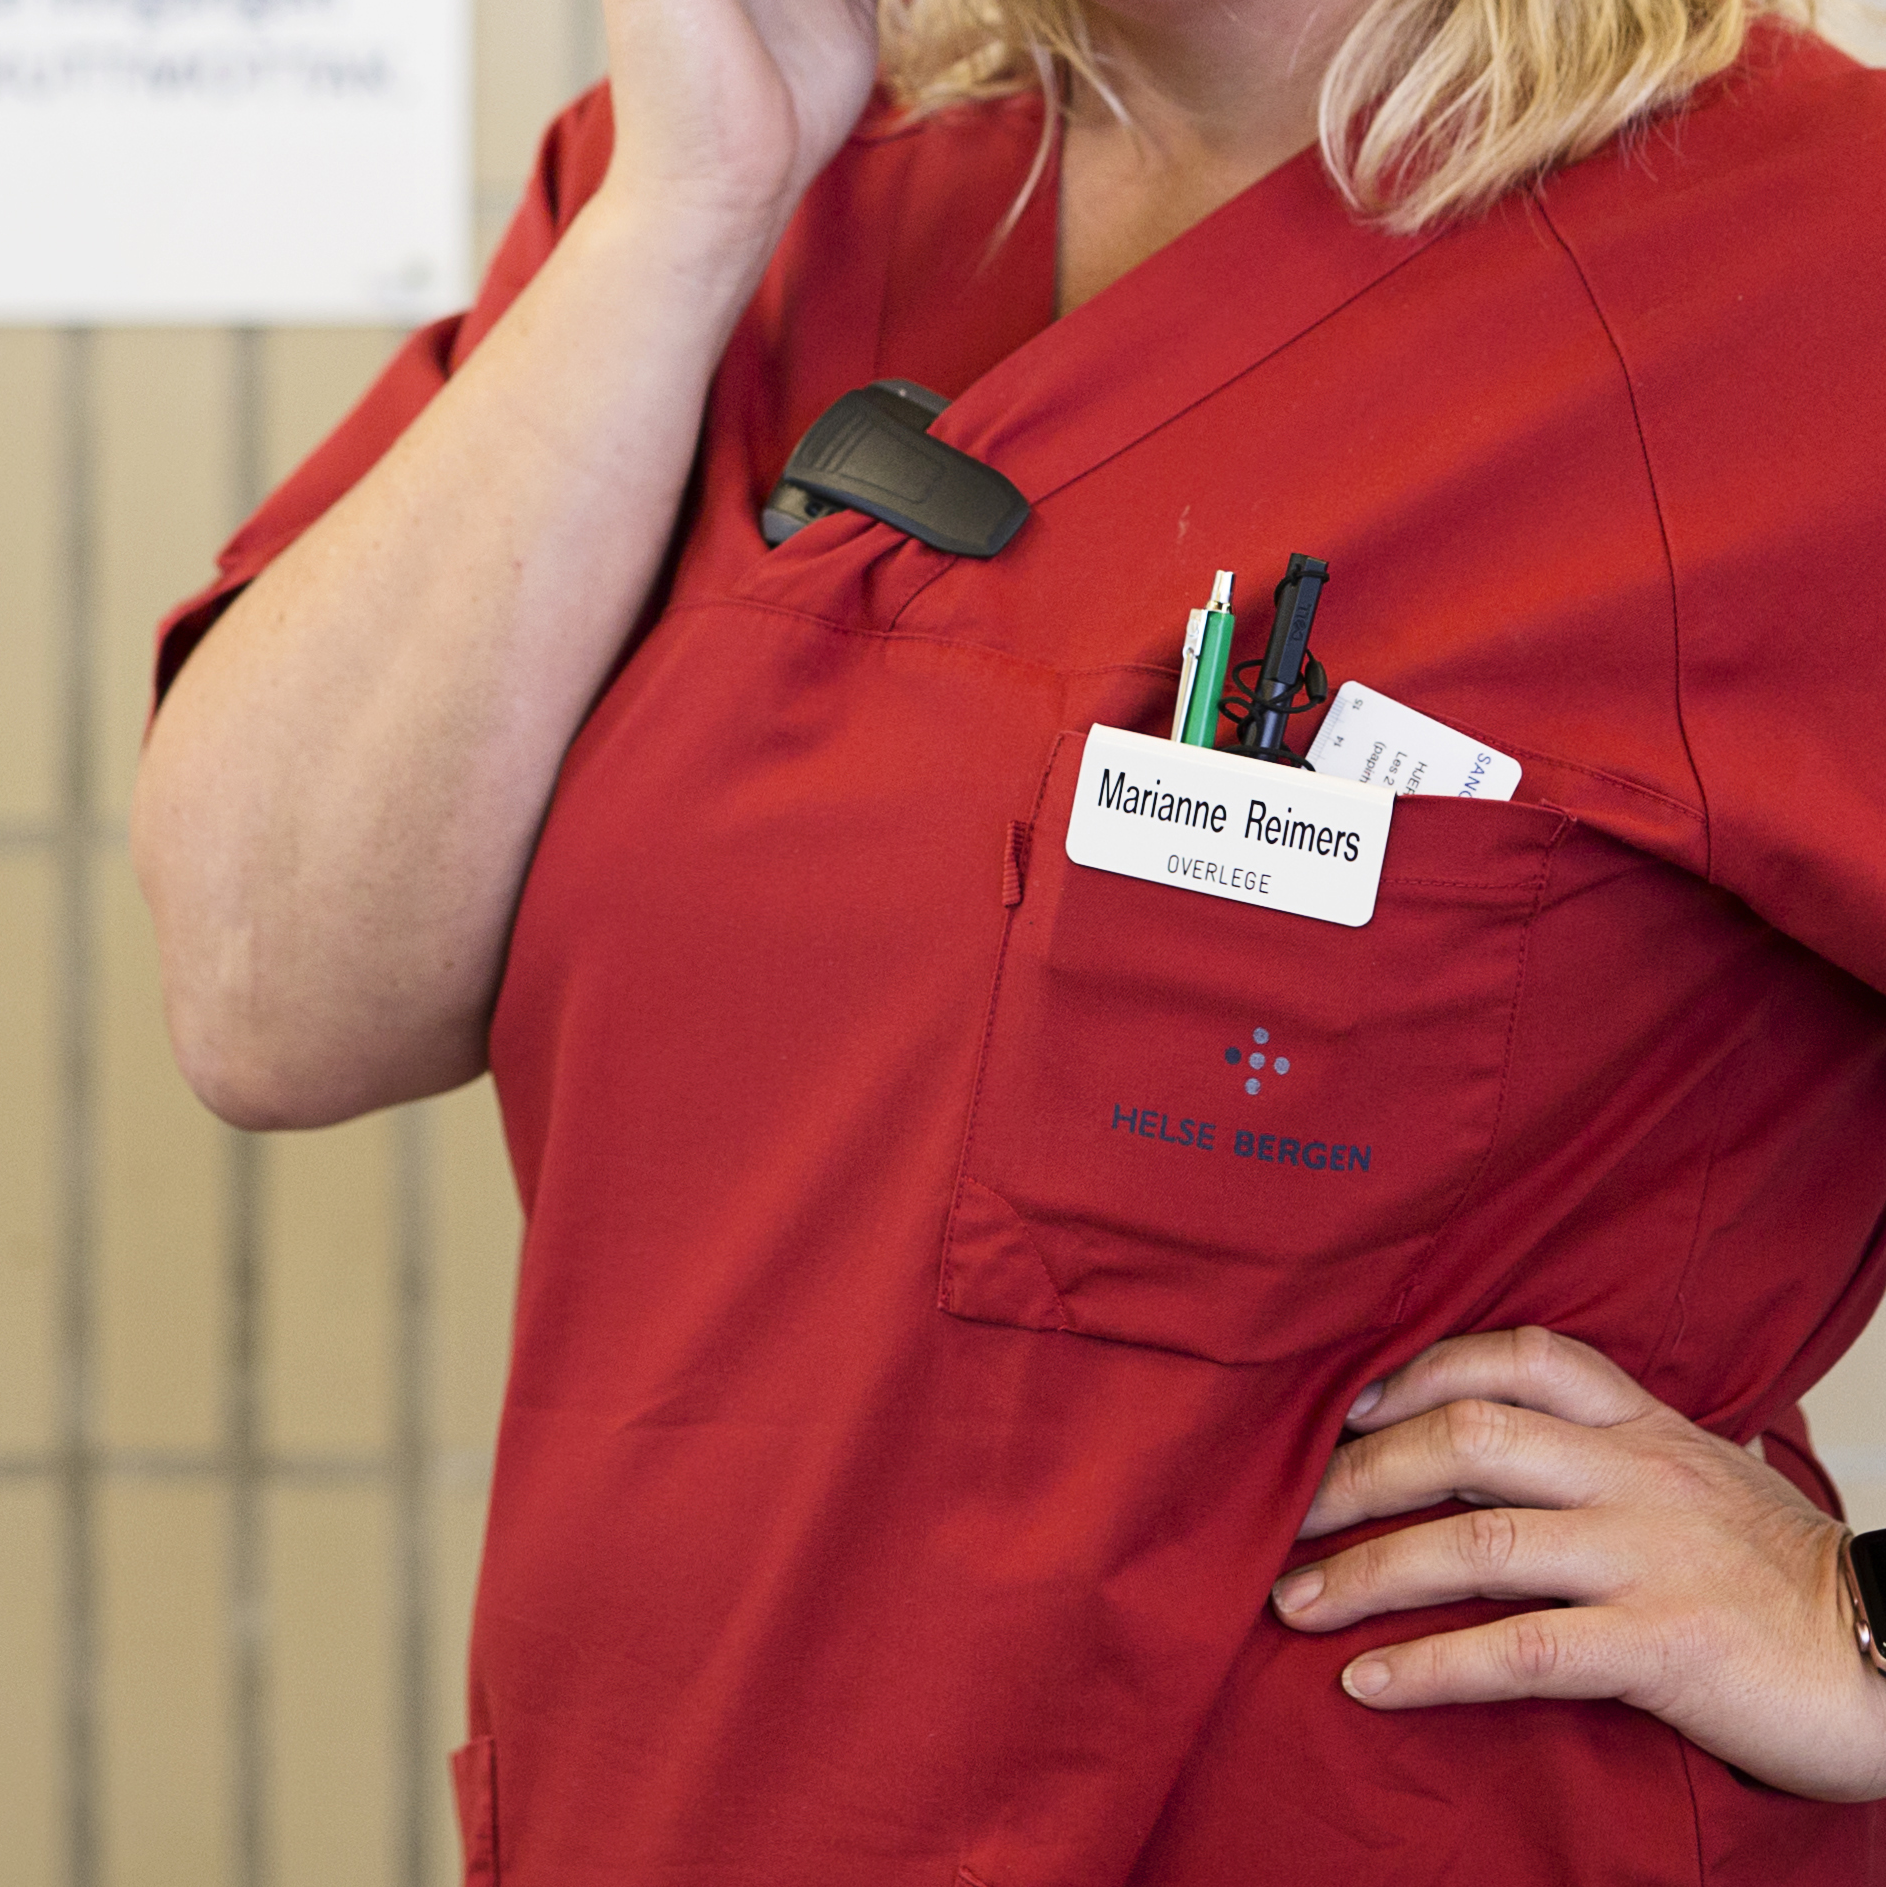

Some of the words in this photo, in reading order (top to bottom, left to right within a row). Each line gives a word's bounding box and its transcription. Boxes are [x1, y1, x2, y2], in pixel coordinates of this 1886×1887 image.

[1352, 697, 1364, 711] 15
[1333, 735, 1345, 748] 14
[1389, 751, 1408, 775] Les
[1383, 775, 1396, 787] 2
[1097, 767, 1228, 834] Marianne
[1244, 798, 1362, 864] Reimers
[1166, 853, 1273, 895] OVERLEGE
[1111, 1103, 1217, 1152] HELSE
[1232, 1129, 1374, 1174] BERGEN
